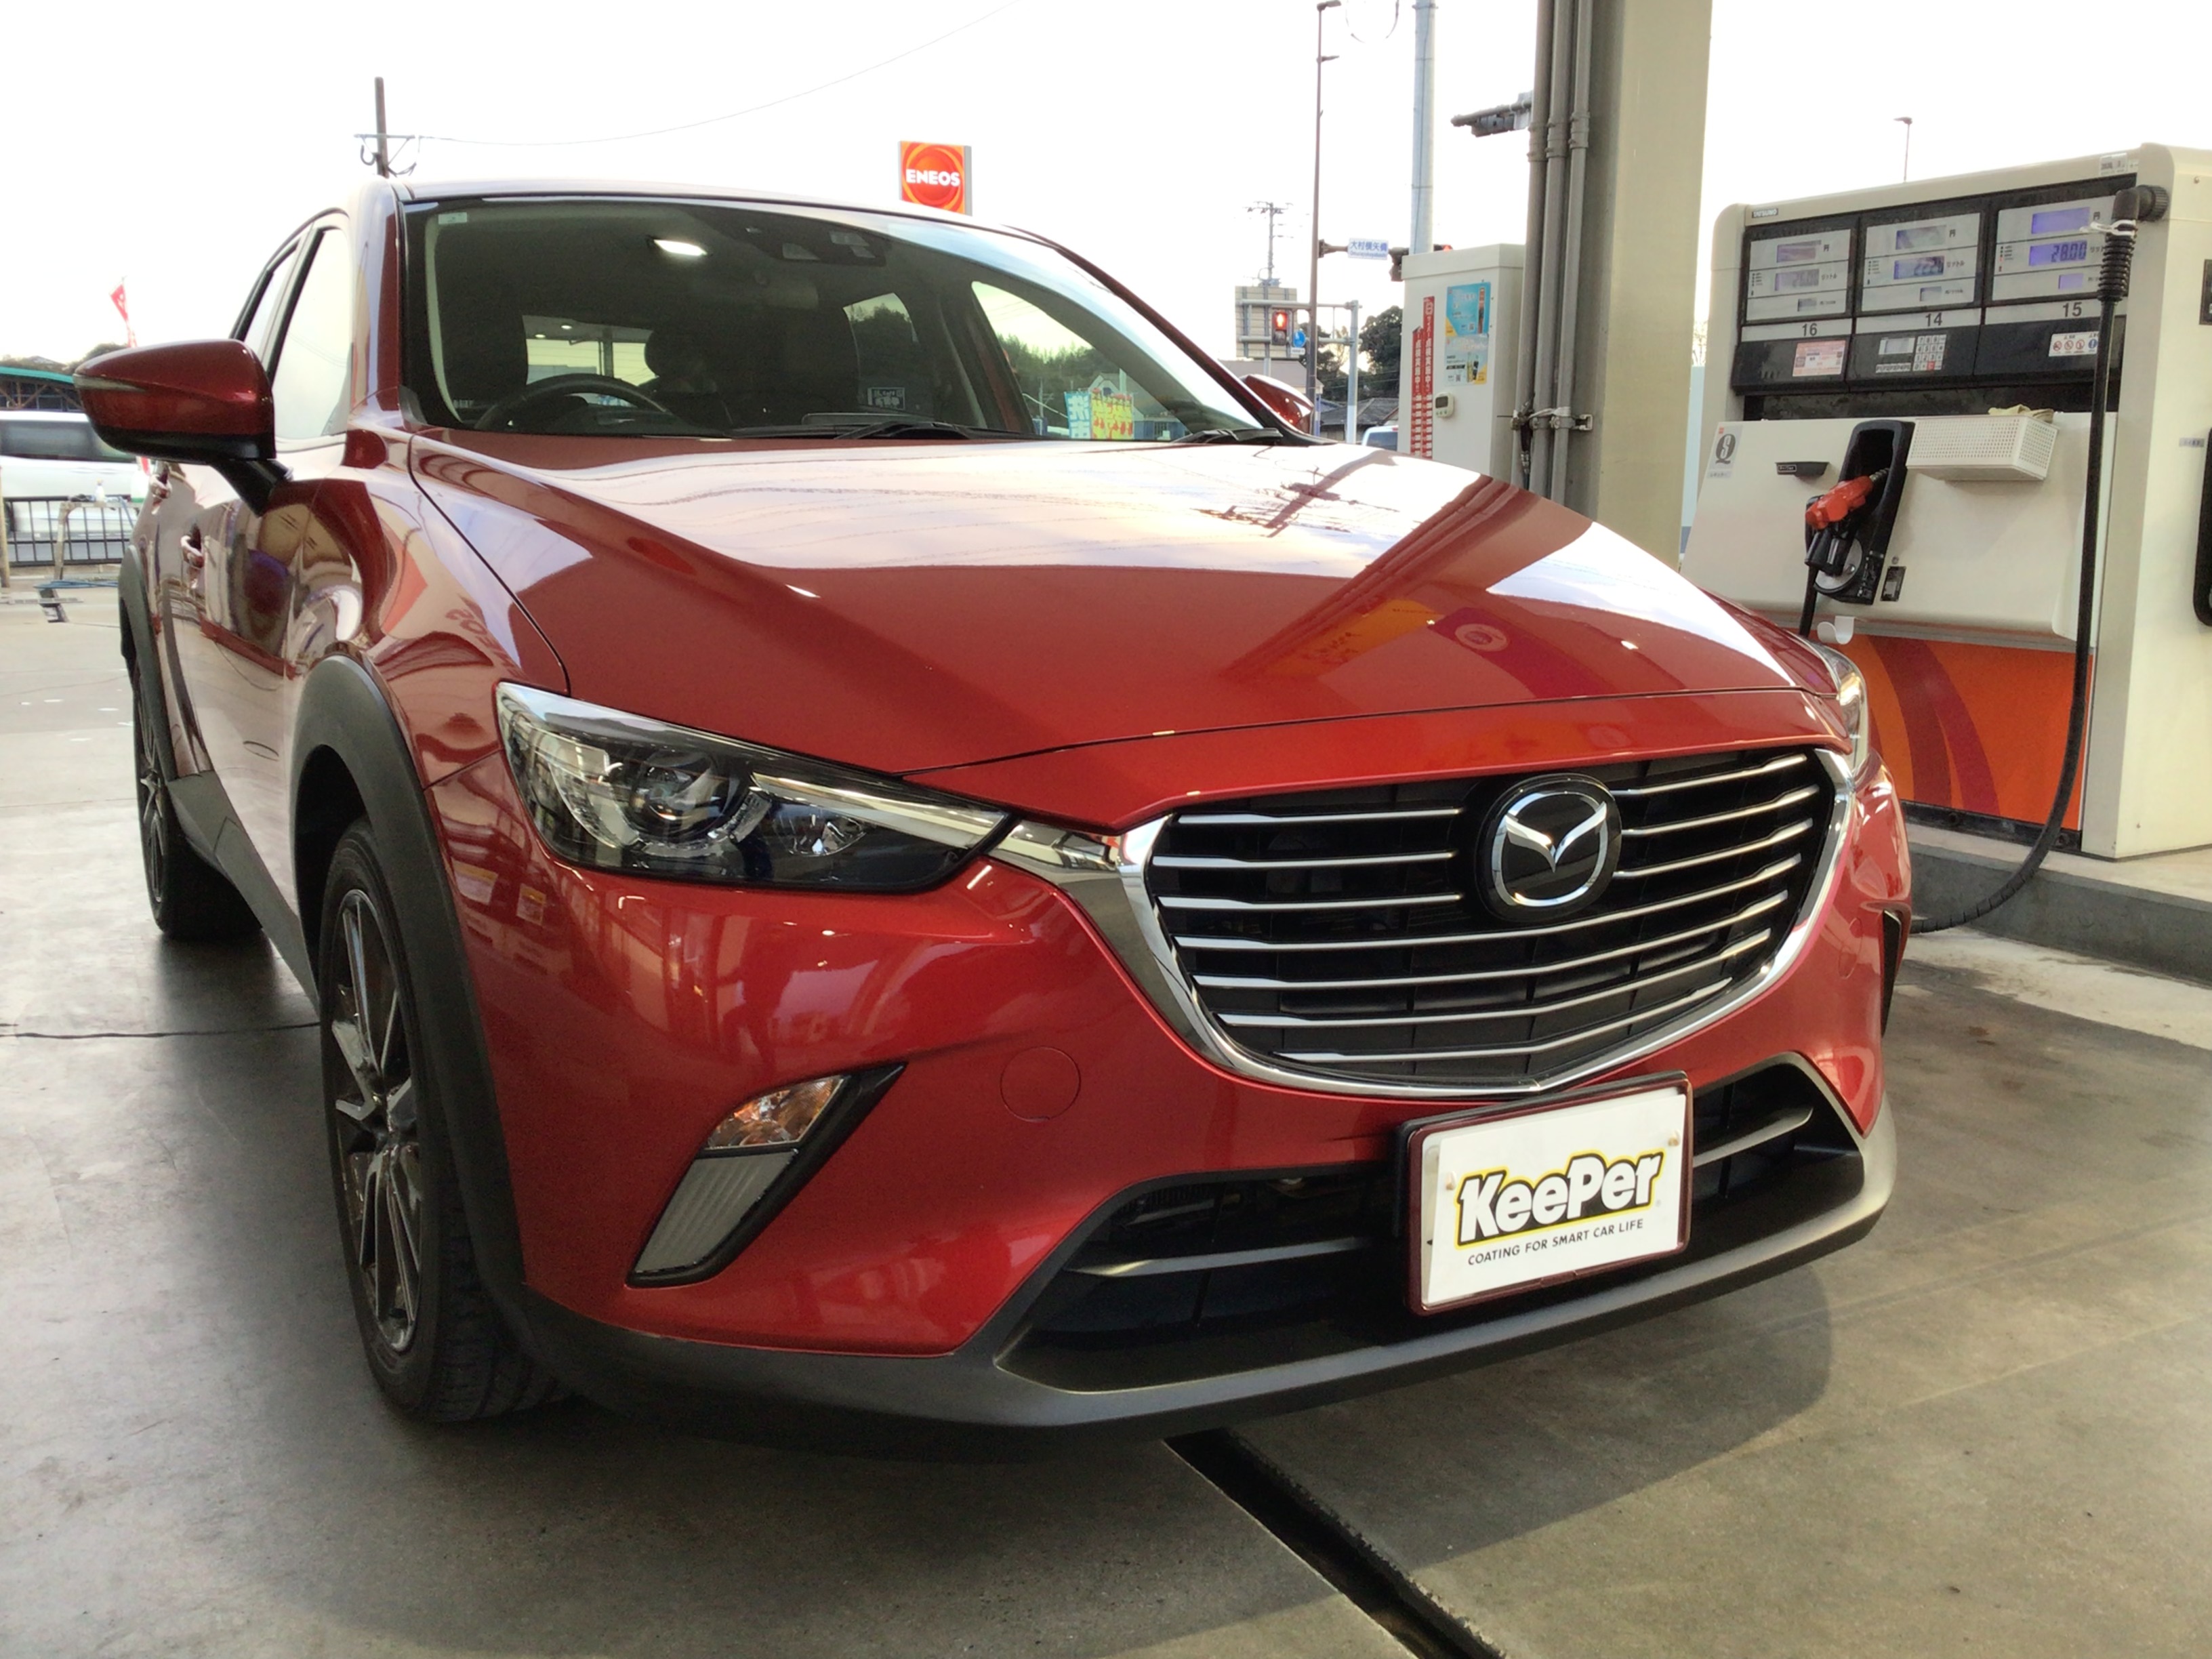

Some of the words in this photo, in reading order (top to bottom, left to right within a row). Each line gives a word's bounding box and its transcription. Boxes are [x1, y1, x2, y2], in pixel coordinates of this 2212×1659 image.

[905, 168, 961, 187] ENEOS
[2062, 302, 2083, 318] 15
[1925, 312, 1942, 327] 14
[1802, 323, 1818, 337] 16
[1457, 1151, 1664, 1246] KeePer
[1467, 1245, 1521, 1265] COATING
[1525, 1239, 1548, 1253] FOR
[1552, 1230, 1590, 1248] SMART
[1593, 1225, 1615, 1238] CAR
[1619, 1218, 1644, 1233] LIFE
